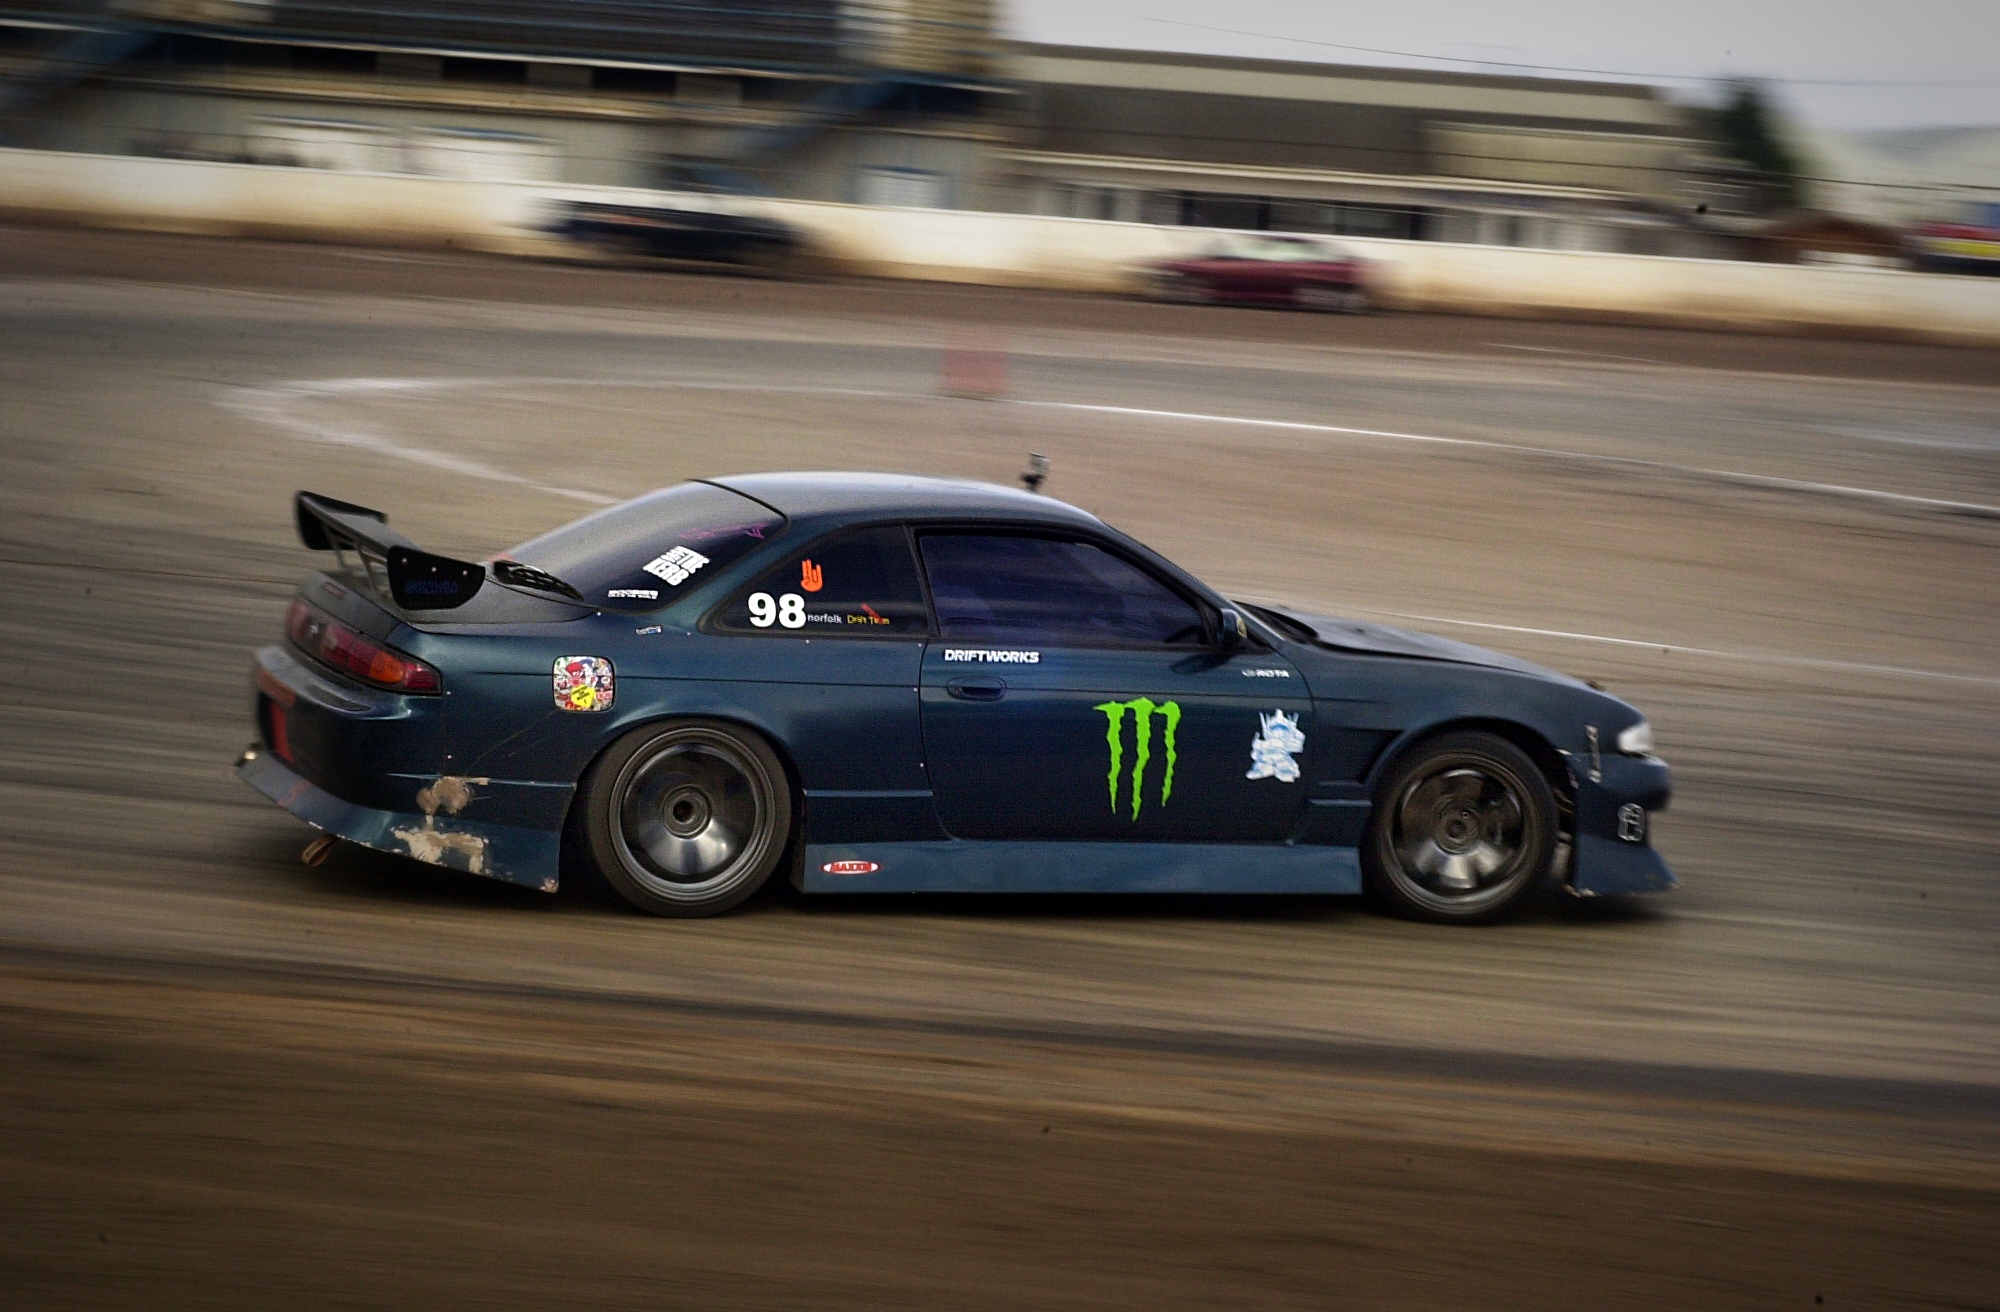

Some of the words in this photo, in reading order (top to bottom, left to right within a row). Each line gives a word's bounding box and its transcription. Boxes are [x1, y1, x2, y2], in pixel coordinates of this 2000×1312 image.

[748, 592, 806, 628] 98
[807, 613, 843, 624] norfolk
[945, 649, 1040, 663] DRIFTWORKS
